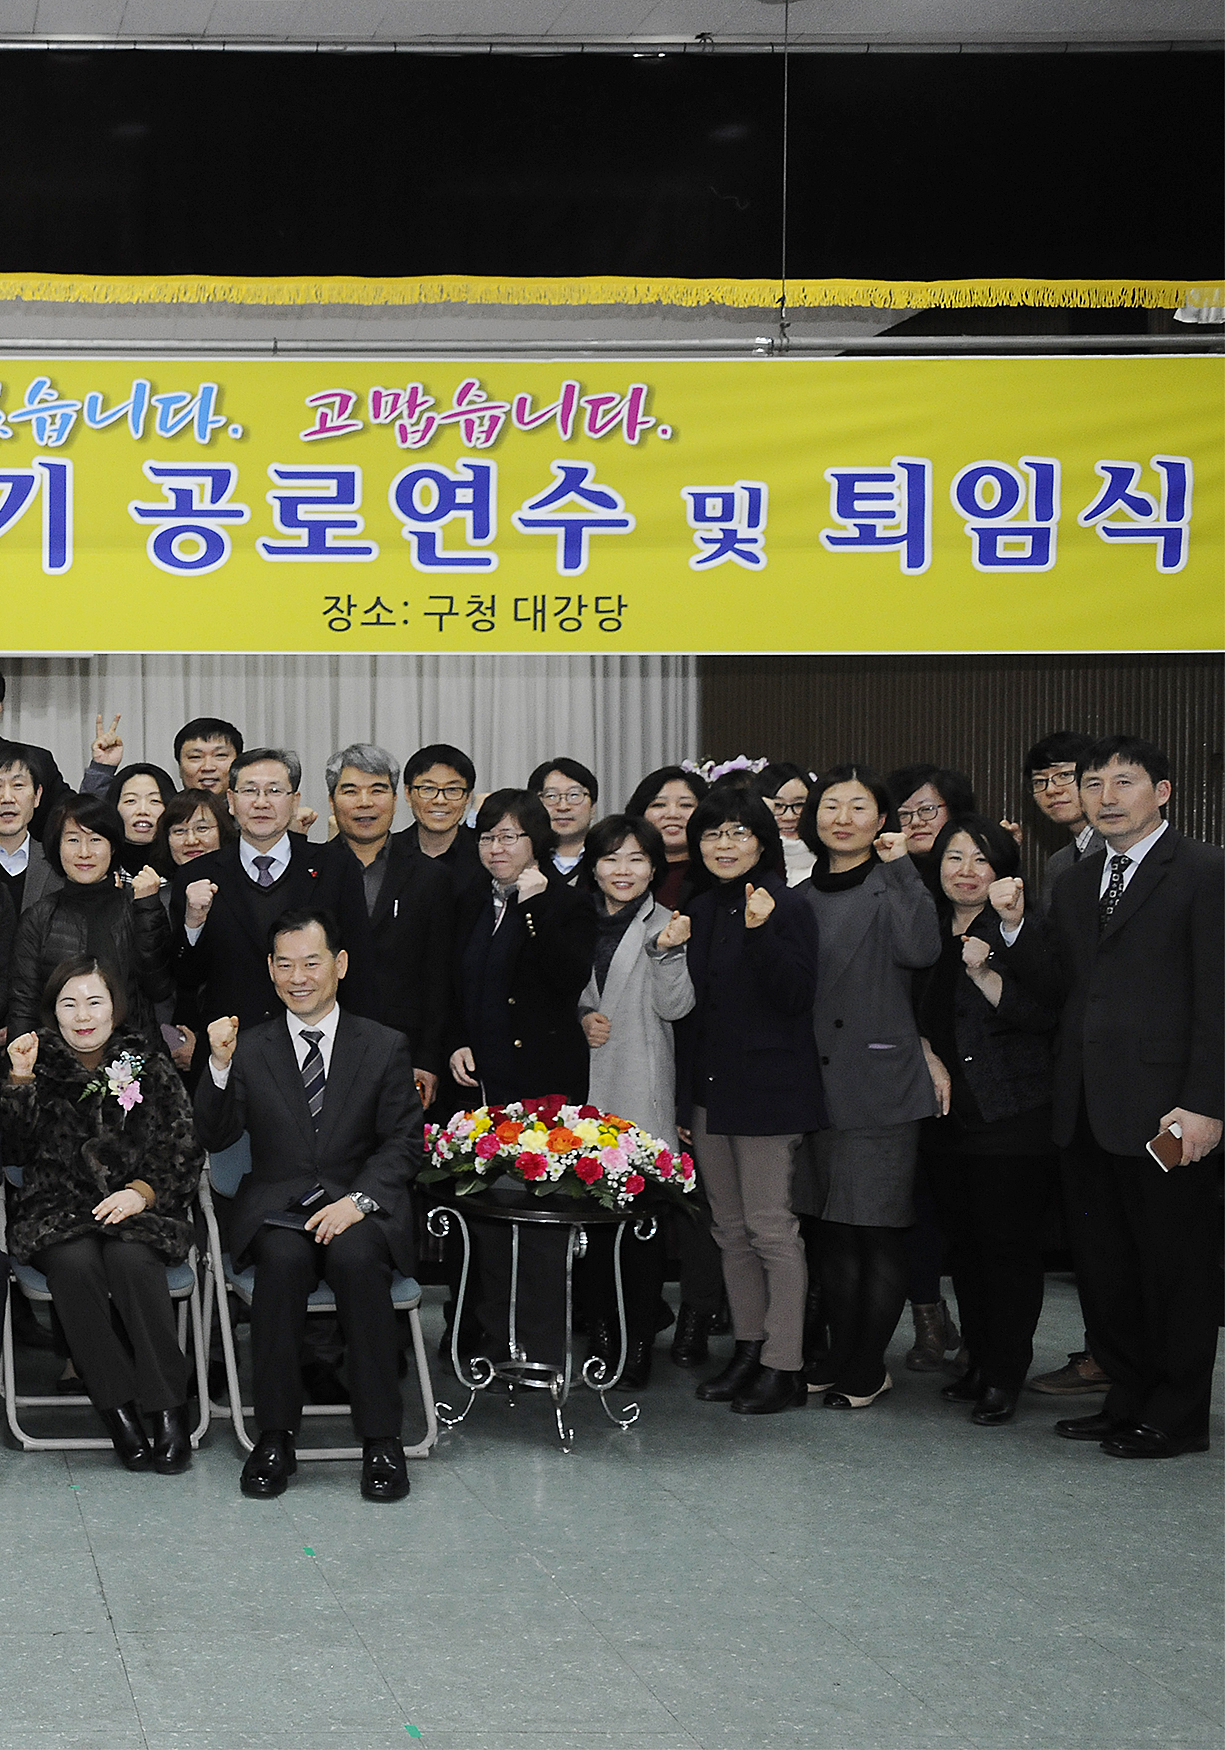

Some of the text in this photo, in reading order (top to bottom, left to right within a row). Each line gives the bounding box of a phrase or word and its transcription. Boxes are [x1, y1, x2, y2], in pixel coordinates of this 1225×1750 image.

[300, 378, 671, 447] 고맙습니다.
[130, 459, 633, 572] 공로연수
[684, 481, 766, 567] 및
[821, 457, 1190, 571] 퇴임식
[322, 593, 628, 633] 장소: 구청 대강당
